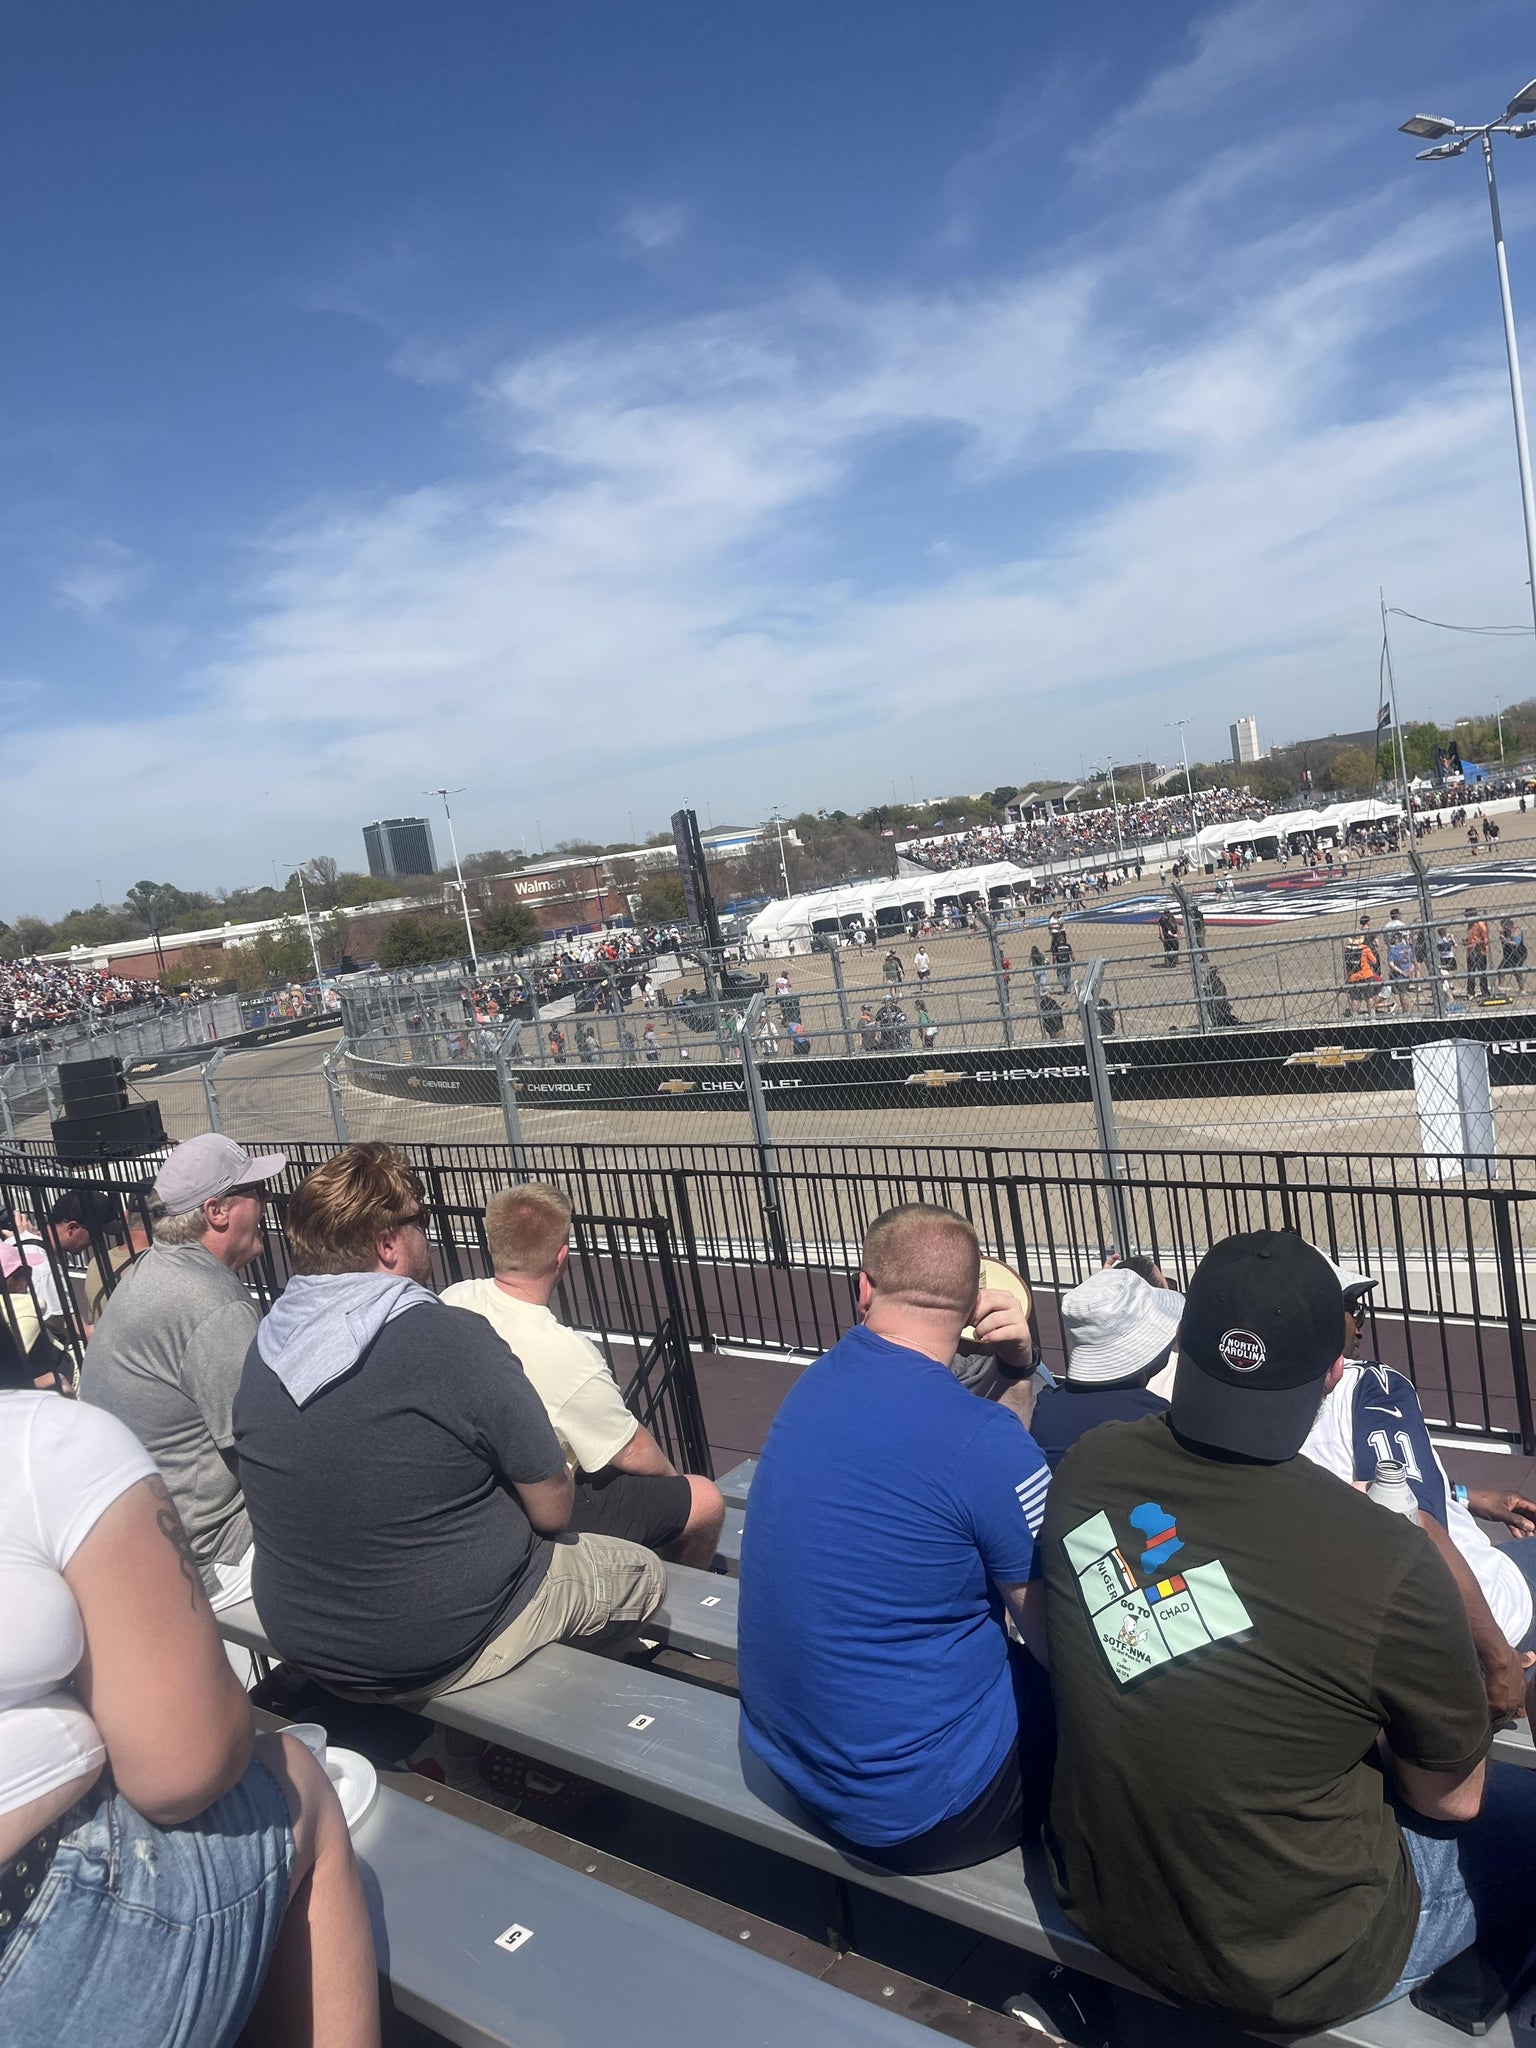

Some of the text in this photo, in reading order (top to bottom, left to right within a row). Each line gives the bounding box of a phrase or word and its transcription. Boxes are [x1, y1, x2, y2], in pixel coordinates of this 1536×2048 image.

[422, 1080, 460, 1089] CHEVROLET
[527, 1083, 592, 1092] CHEVROLET
[701, 1079, 802, 1091] CHEVOLET
[1218, 1343, 1266, 1362] CAROLINA
[1227, 1338, 1259, 1352] NORTH
[1367, 1430, 1423, 1483] 11
[1096, 1560, 1118, 1600] NIGER
[1120, 1599, 1151, 1619] GO TO
[1159, 1602, 1190, 1621] CHAD
[1102, 1633, 1152, 1664] SOTF-NWA
[505, 1931, 522, 1944] 5
